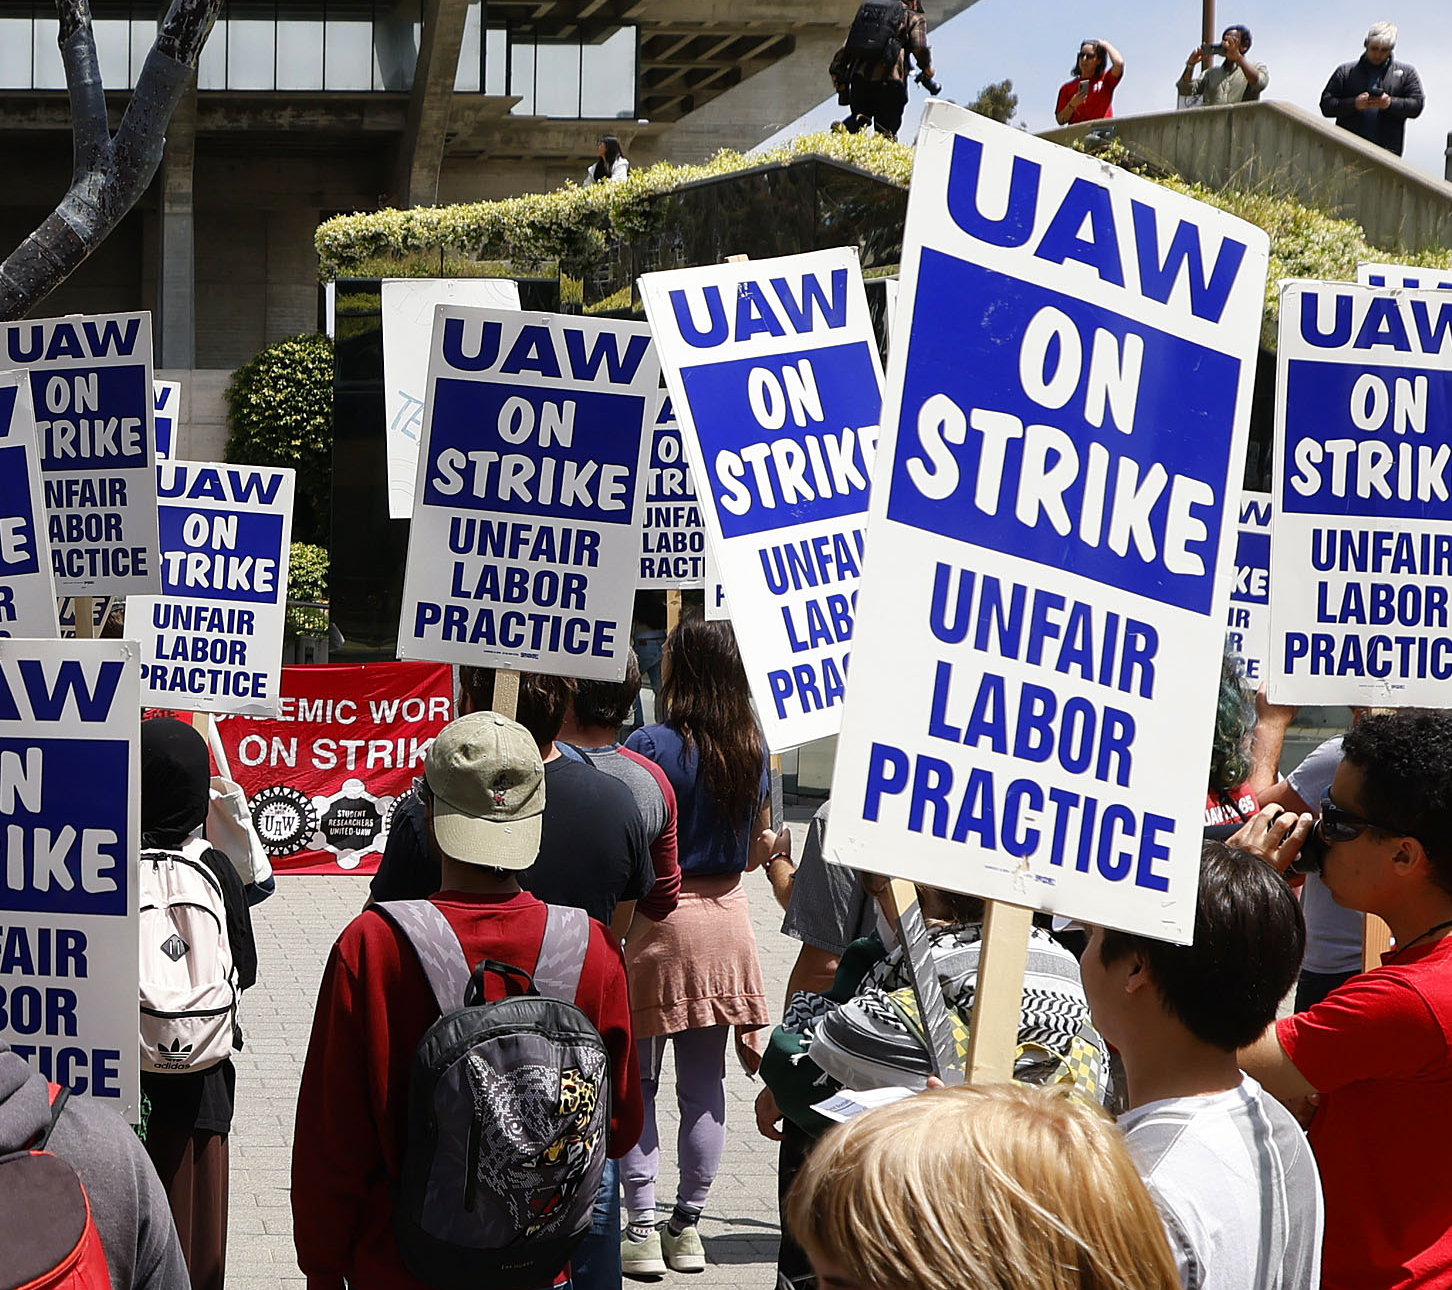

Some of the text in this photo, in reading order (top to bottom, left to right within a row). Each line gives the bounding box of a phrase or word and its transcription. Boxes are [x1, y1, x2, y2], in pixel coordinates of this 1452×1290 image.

[946, 133, 1246, 323] UAW
[669, 268, 848, 348] UAW
[8, 319, 140, 362] UAW
[442, 318, 651, 383] UAW
[1018, 305, 1145, 435] ON
[45, 374, 98, 413] ON
[747, 359, 824, 430] ON
[1349, 373, 1428, 434] ON
[39, 417, 141, 459] TRIKE
[496, 397, 575, 449] ON
[658, 436, 687, 463] O
[45, 478, 127, 508] NFAIR
[156, 465, 283, 505] UAW
[432, 448, 629, 511] STRIKE
[906, 392, 1215, 577] STRIKE
[49, 513, 122, 543] ABOR
[183, 513, 238, 550] ON
[449, 518, 600, 567] UNFAIR
[643, 532, 704, 552] LABO
[52, 548, 148, 577] ACTICE
[160, 551, 275, 592] TRIKE
[451, 562, 587, 609] LABOR
[1318, 581, 1448, 628] LABOR
[153, 604, 254, 636] UNFAIR
[414, 604, 616, 658] PRACTICE
[929, 562, 1160, 699] UNFAIR
[156, 635, 246, 665] LABOR
[929, 660, 1134, 788] LABOR
[239, 734, 436, 770] ON STRIK
[265, 816, 295, 835] UAW
[863, 742, 1177, 892] PRACTICE
[154, 1061, 191, 1070] adidas
